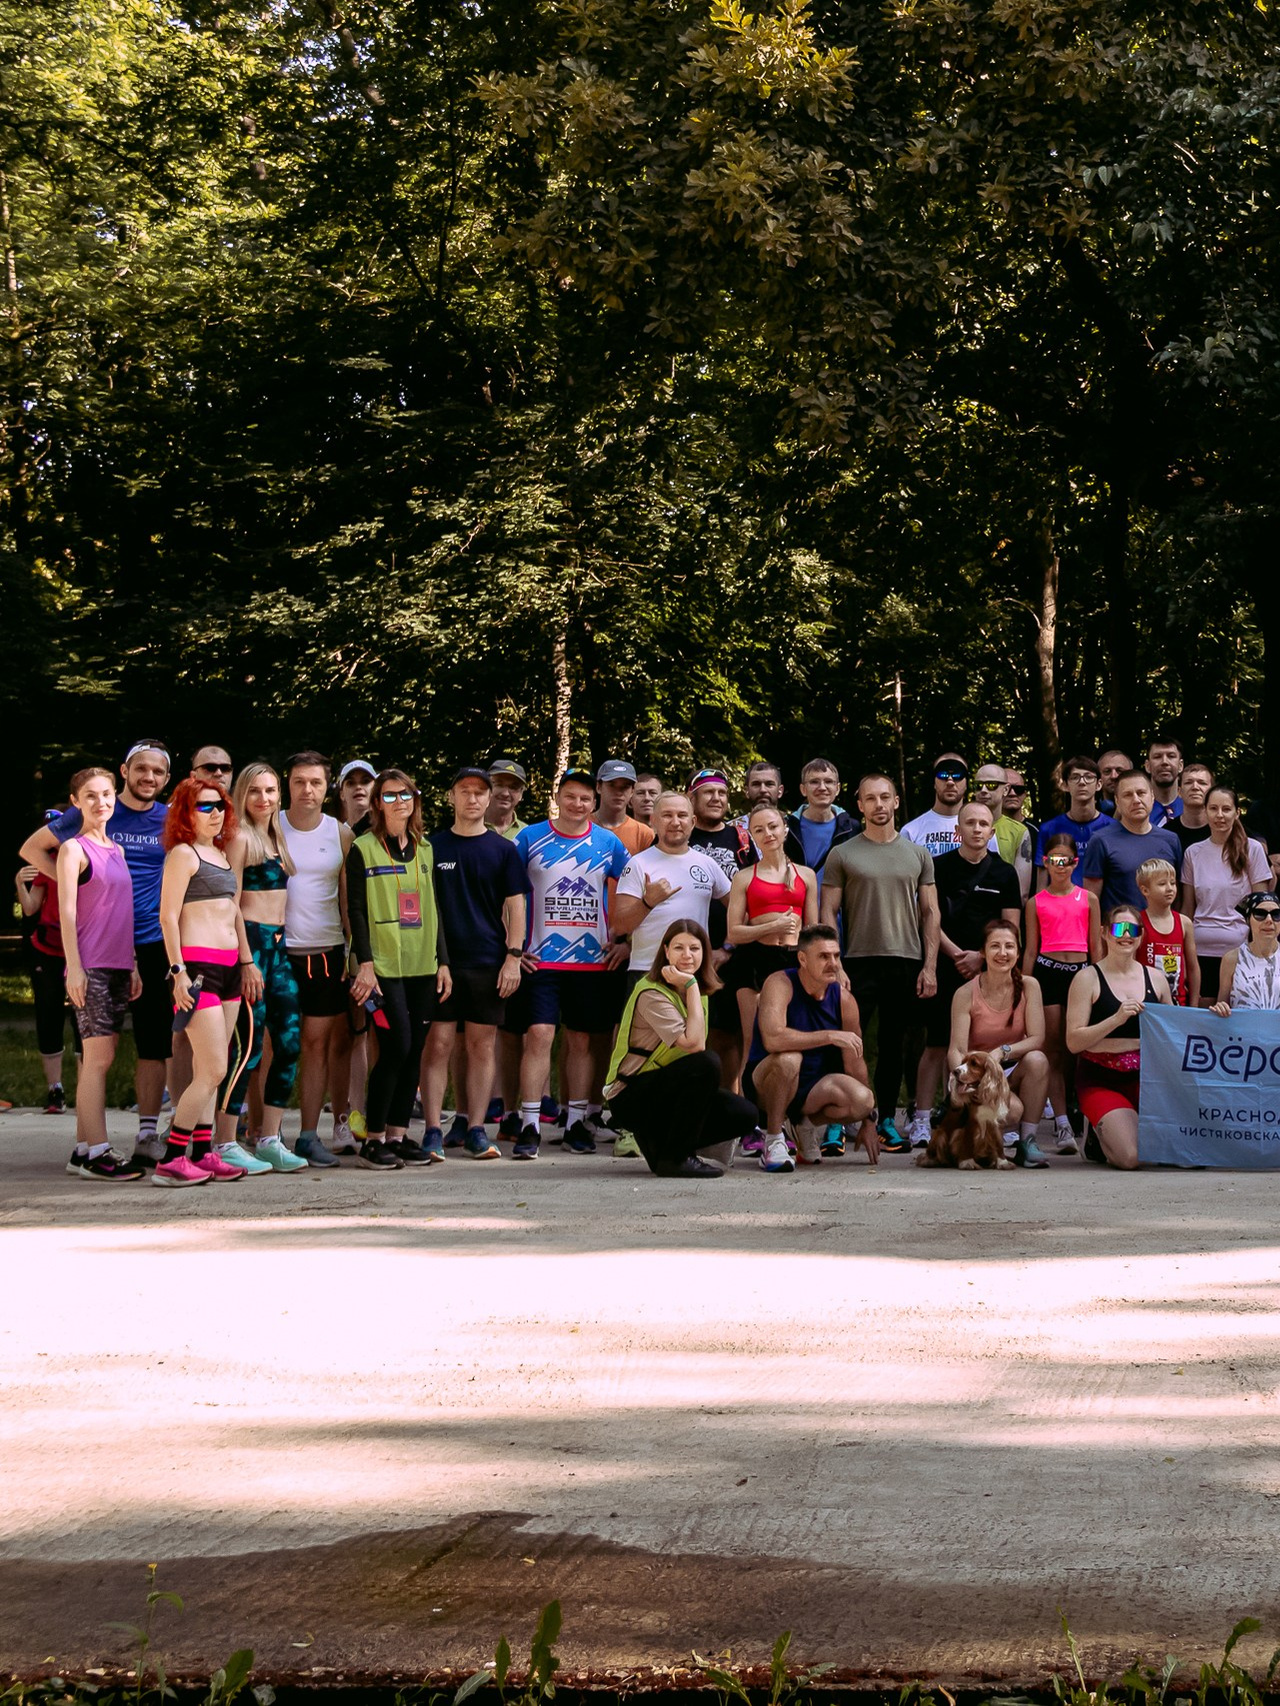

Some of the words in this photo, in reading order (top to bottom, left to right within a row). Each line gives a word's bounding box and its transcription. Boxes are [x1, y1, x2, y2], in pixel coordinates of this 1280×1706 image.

[112, 832, 159, 845] СУВОРОВ
[925, 831, 963, 843] #ЗАБЕГ20
[437, 862, 457, 870] RAY
[544, 897, 599, 908] SOCHI
[544, 911, 599, 921] TEAM
[1146, 942, 1154, 964] COOL
[1053, 962, 1078, 972] PRO
